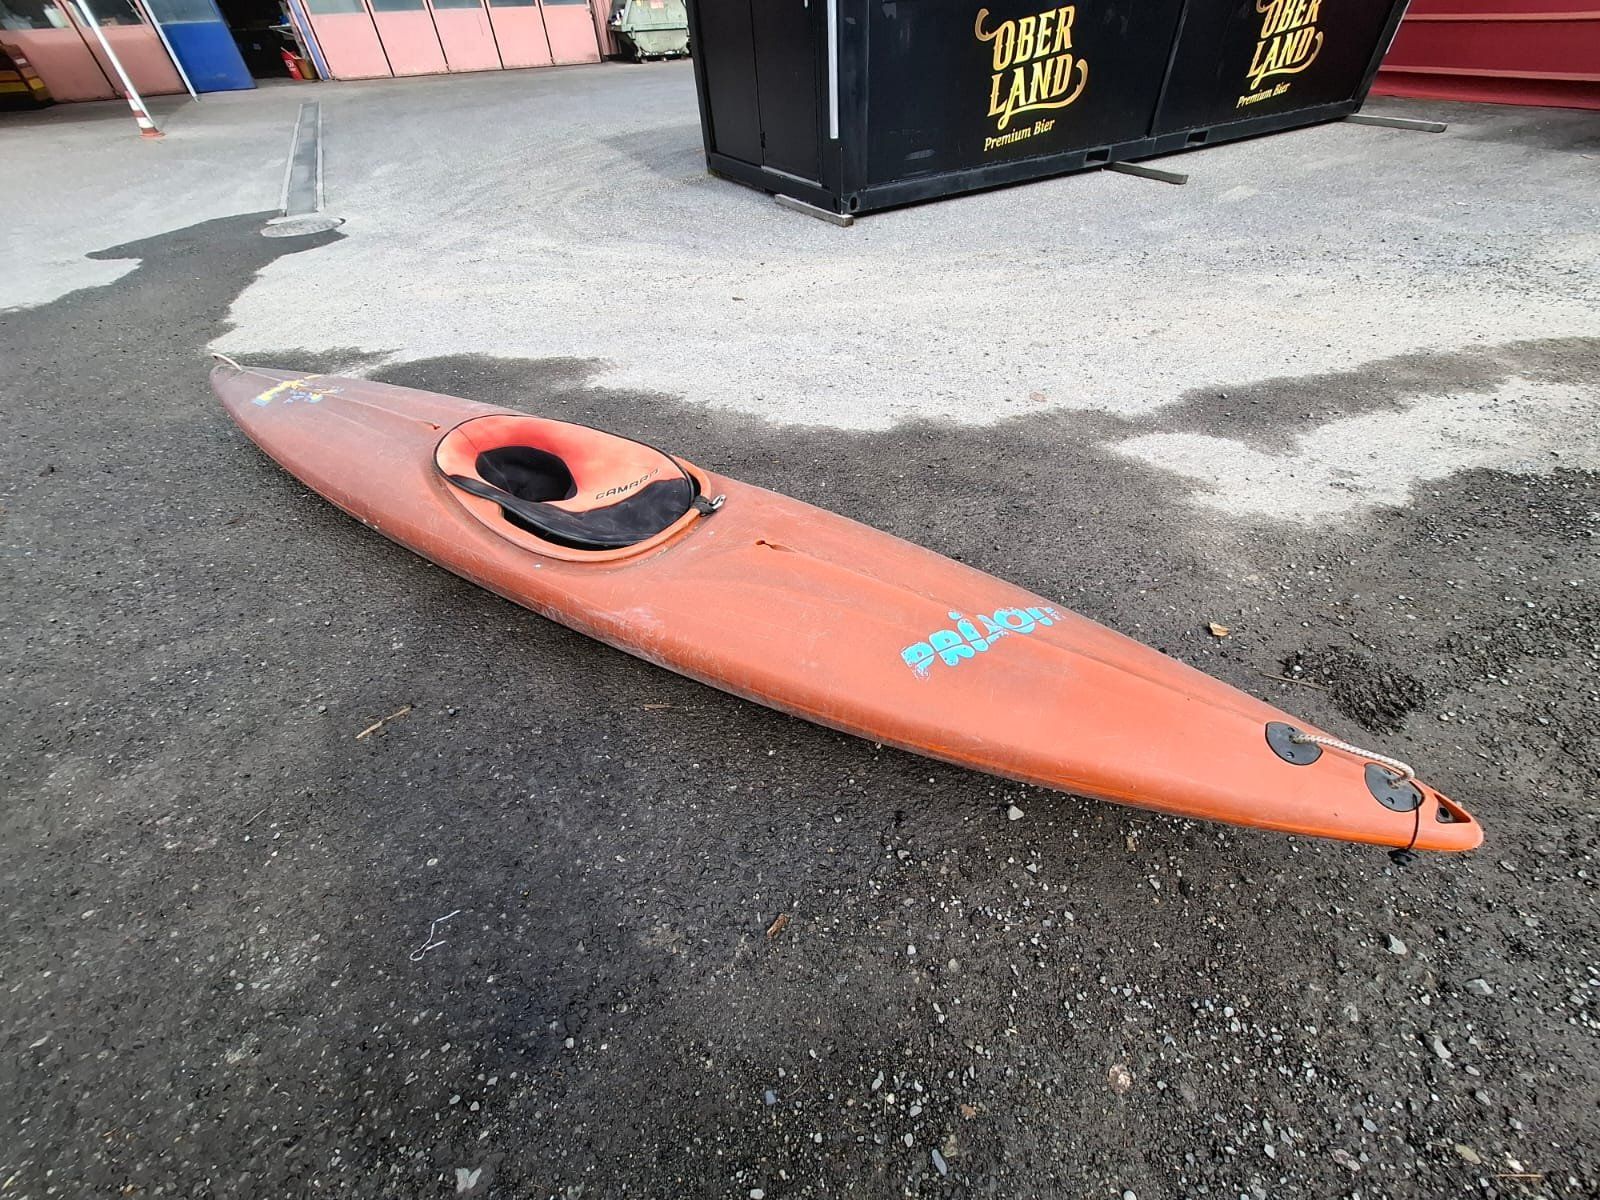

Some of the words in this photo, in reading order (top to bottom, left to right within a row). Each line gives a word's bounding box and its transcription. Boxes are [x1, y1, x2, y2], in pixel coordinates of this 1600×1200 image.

[975, 5, 1076, 71] OBER
[1246, 26, 1324, 90] LAND
[987, 53, 1089, 130] LAND
[1236, 89, 1273, 108] Premium
[1273, 82, 1291, 97] Bier
[984, 128, 1031, 151] Premium
[1033, 118, 1055, 135] Bier
